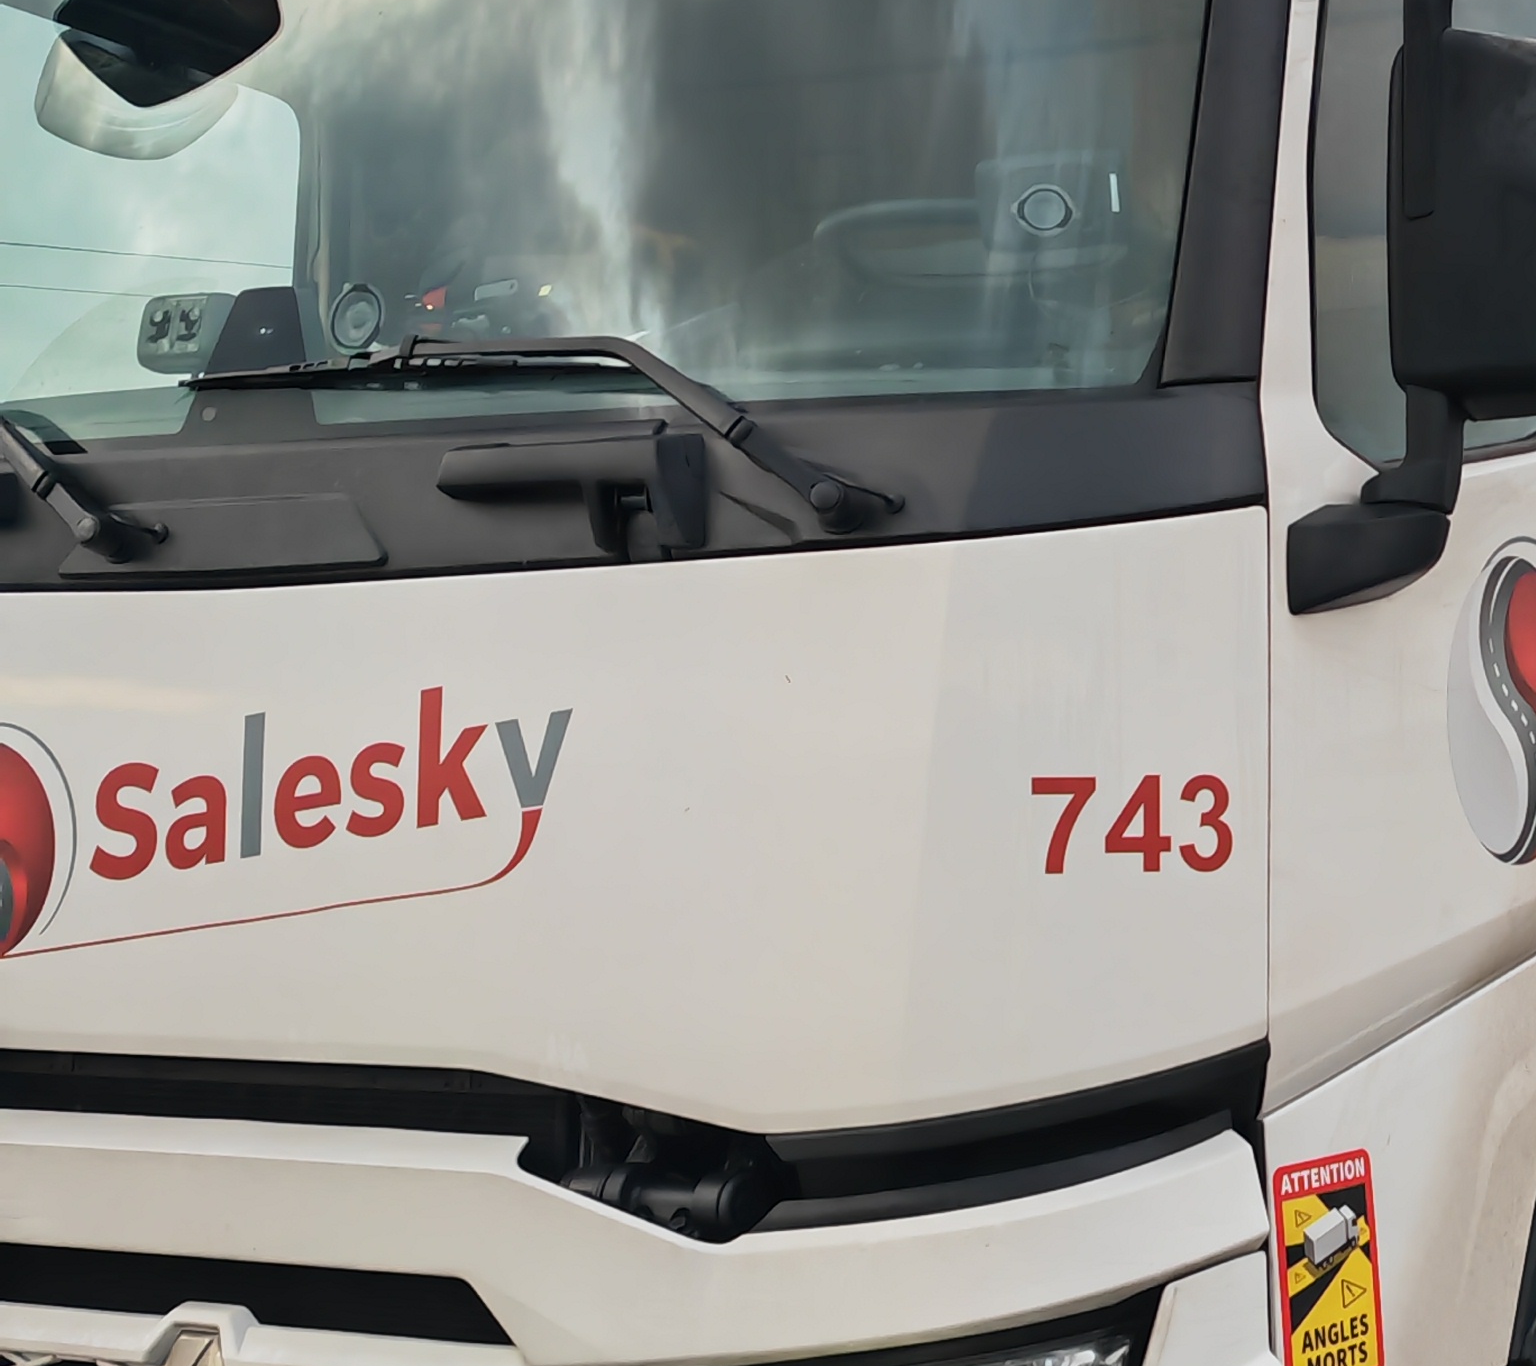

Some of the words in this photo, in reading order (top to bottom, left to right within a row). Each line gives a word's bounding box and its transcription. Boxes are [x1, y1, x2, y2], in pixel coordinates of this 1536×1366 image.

[89, 685, 573, 884] Salesky
[1031, 774, 1233, 874] 743
[1280, 1156, 1366, 1196] ATTENTION
[1301, 1313, 1370, 1354] ANGLES
